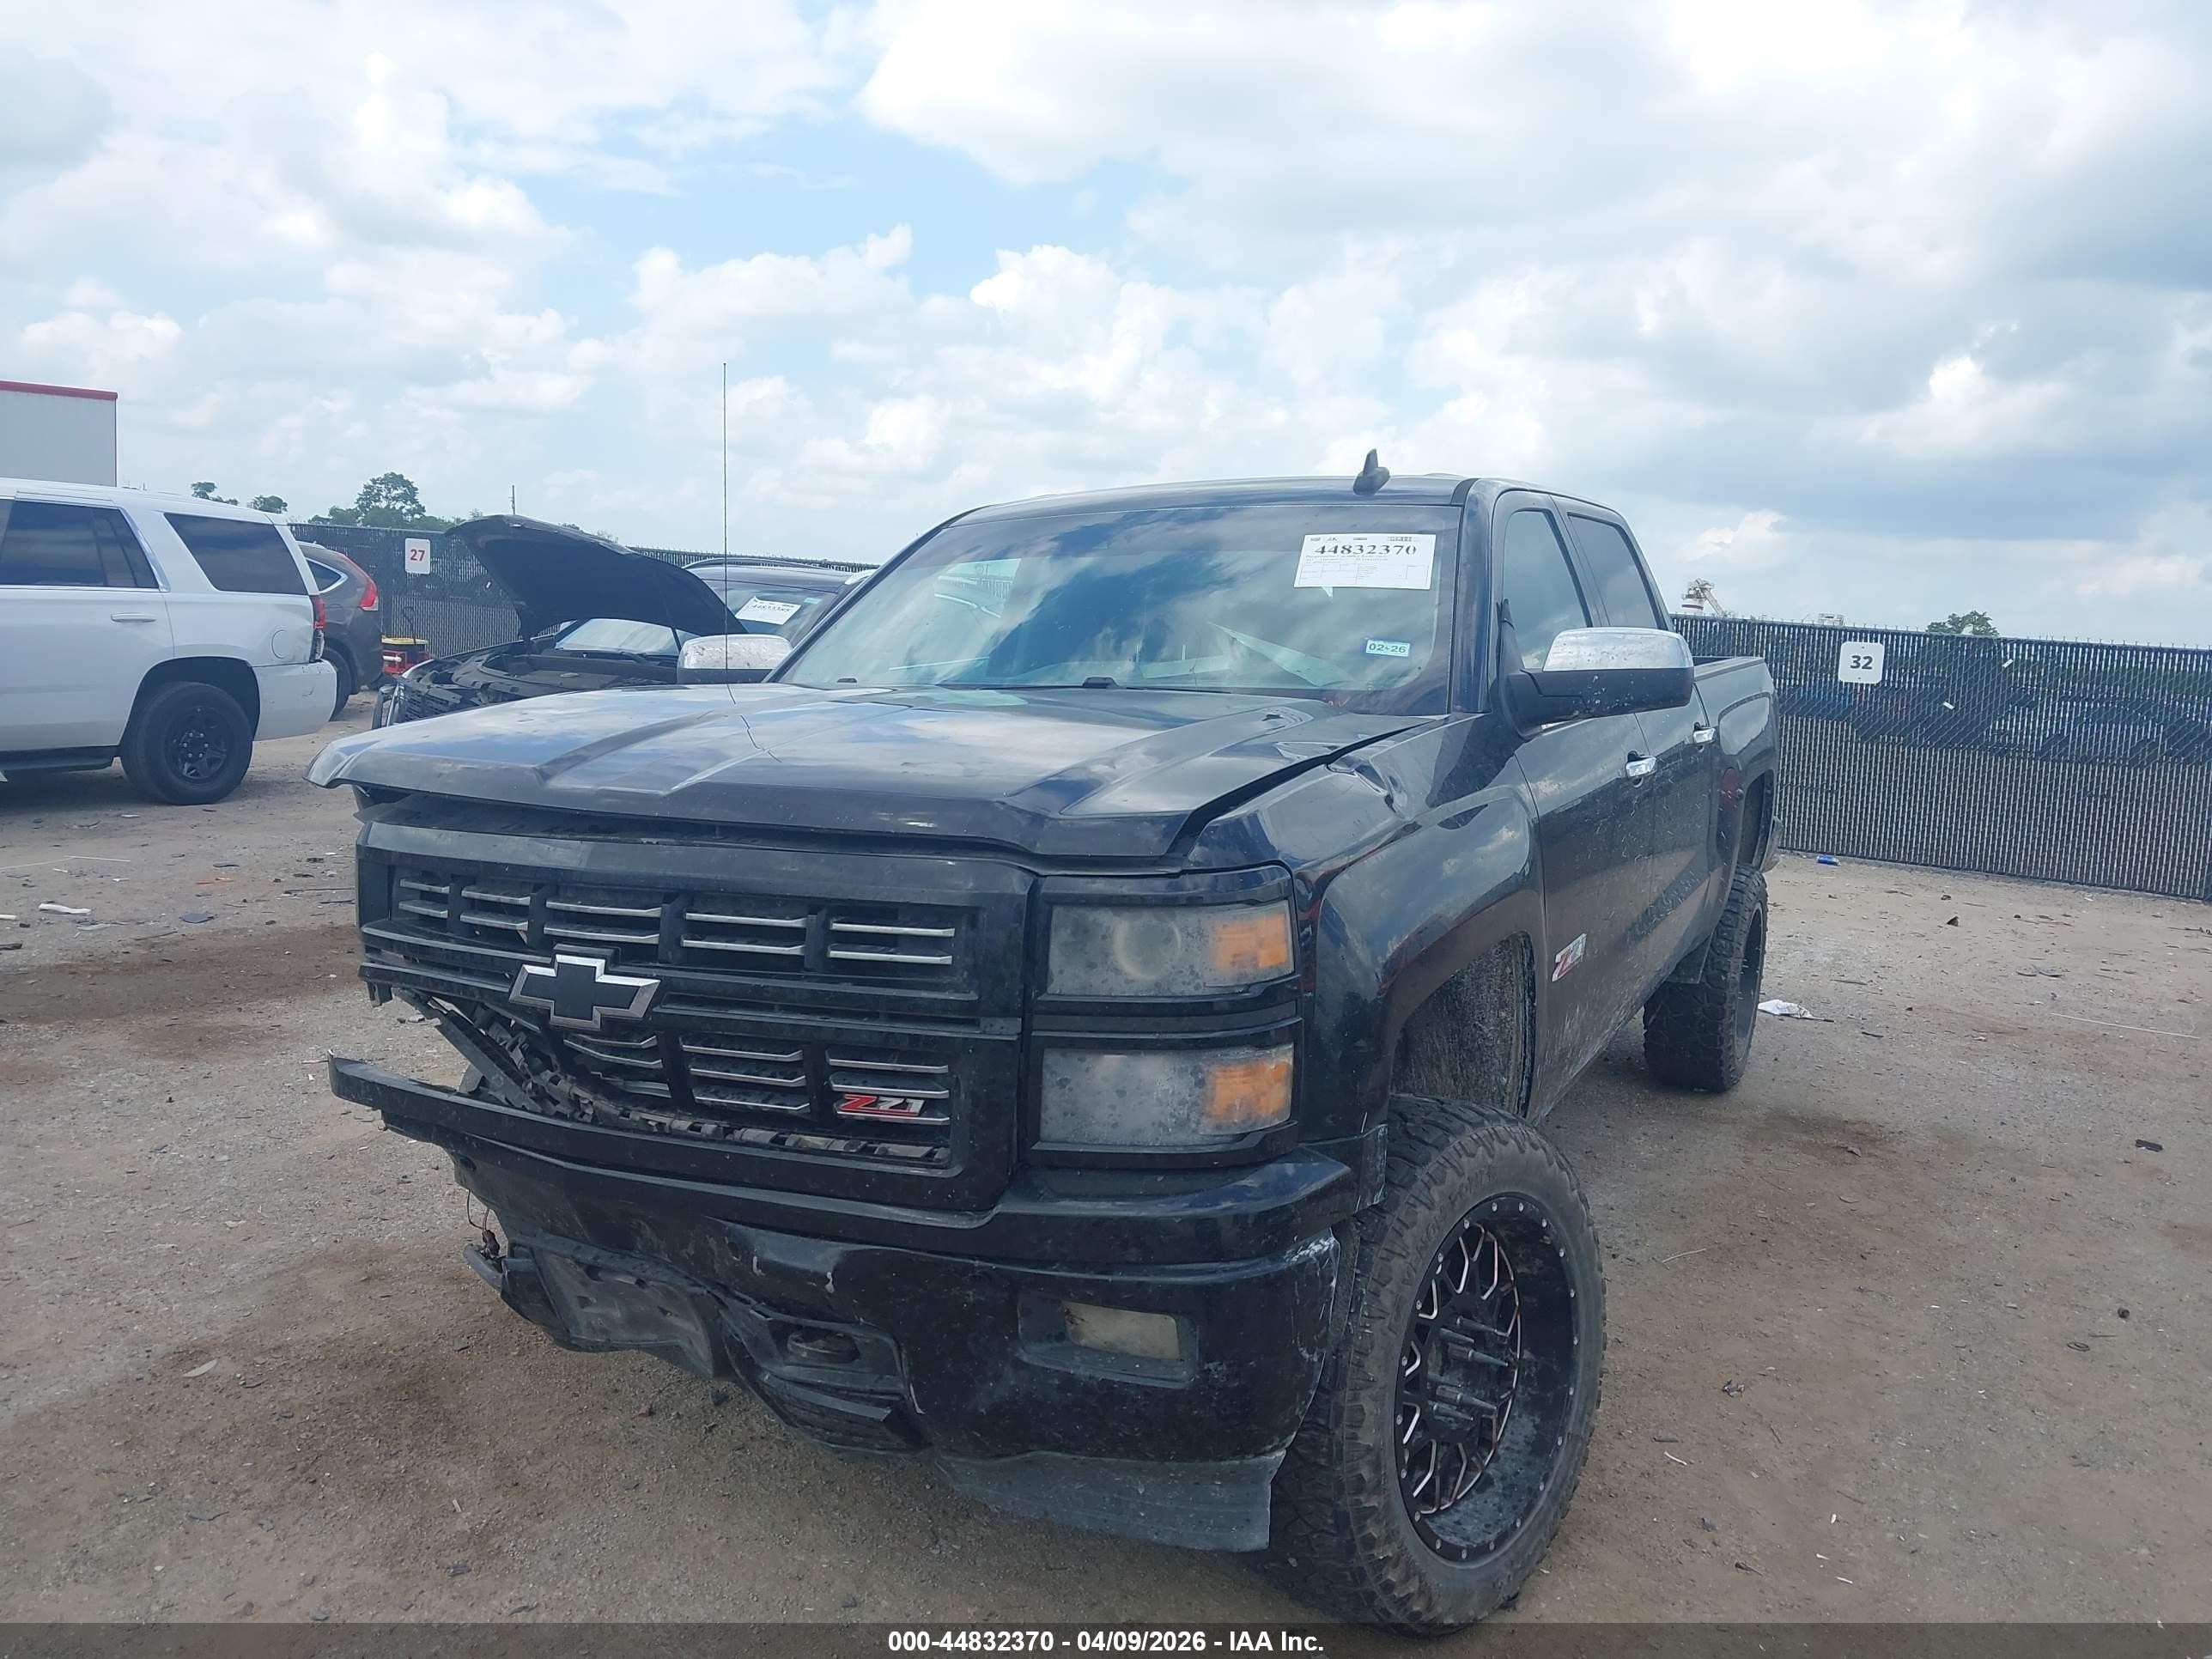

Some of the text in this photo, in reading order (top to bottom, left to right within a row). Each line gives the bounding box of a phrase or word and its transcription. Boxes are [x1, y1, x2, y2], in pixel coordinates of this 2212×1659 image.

[410, 549, 426, 562] 27
[1314, 544, 1418, 556] 44832370
[1850, 654, 1874, 670] 32
[839, 1093, 925, 1116] Z71
